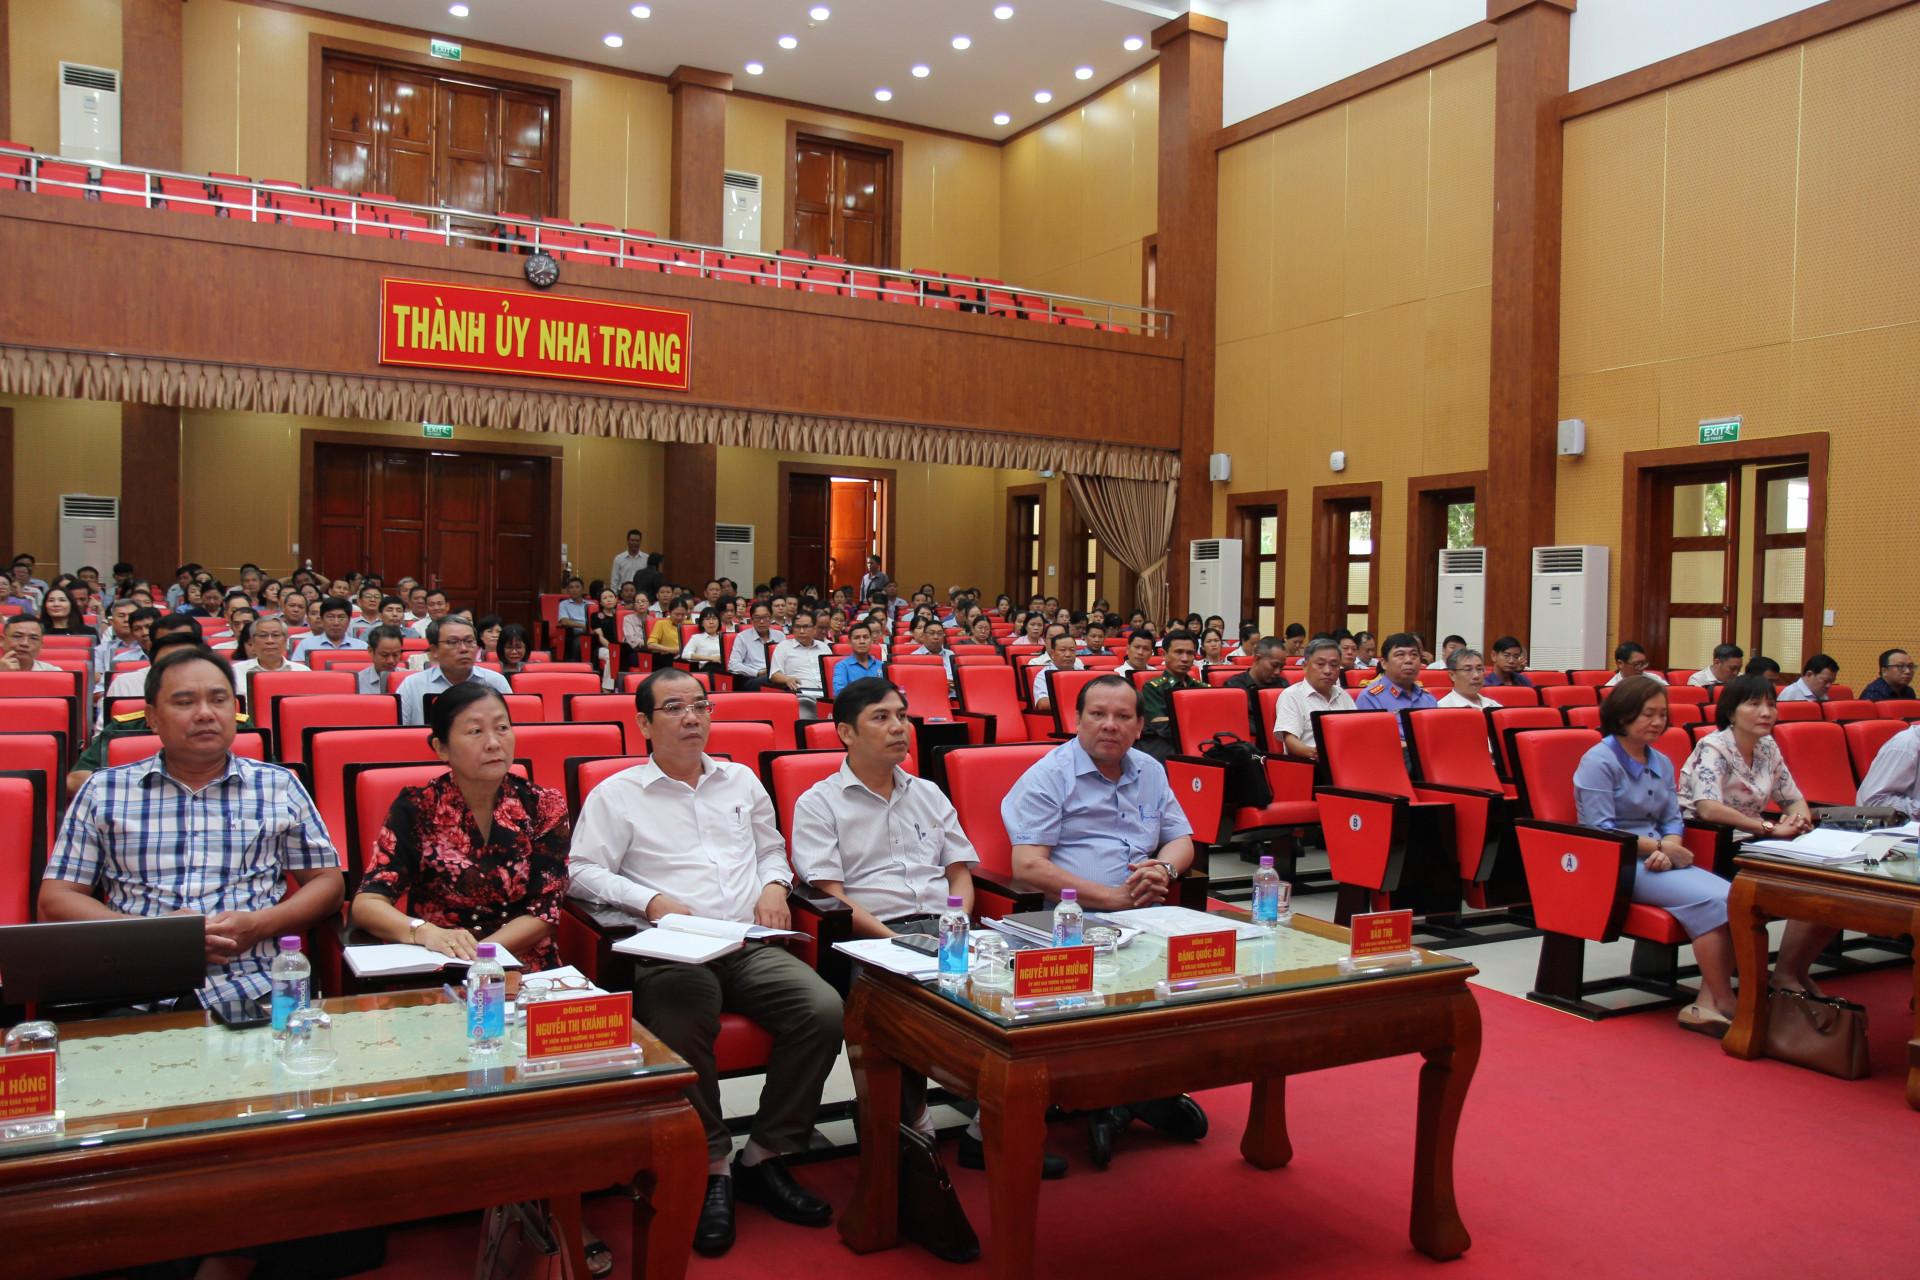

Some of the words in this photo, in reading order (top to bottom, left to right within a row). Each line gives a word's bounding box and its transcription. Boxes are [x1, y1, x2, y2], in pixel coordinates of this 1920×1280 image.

[393, 296, 485, 354] THÀNH
[496, 300, 531, 358] ỦY
[539, 319, 591, 364] NHA
[600, 325, 681, 374] TRANG
[1704, 427, 1724, 437] EXIT
[1566, 856, 1572, 869] A
[1020, 963, 1047, 980] NGUYỄN
[563, 1006, 582, 1014] ĐỒNG
[585, 1004, 597, 1012] CHÍ
[536, 1016, 566, 1036] NGUYỄN
[568, 1020, 580, 1034] THỊ
[581, 1016, 607, 1032] KHÁNH
[9, 1074, 47, 1095] HỒNG
